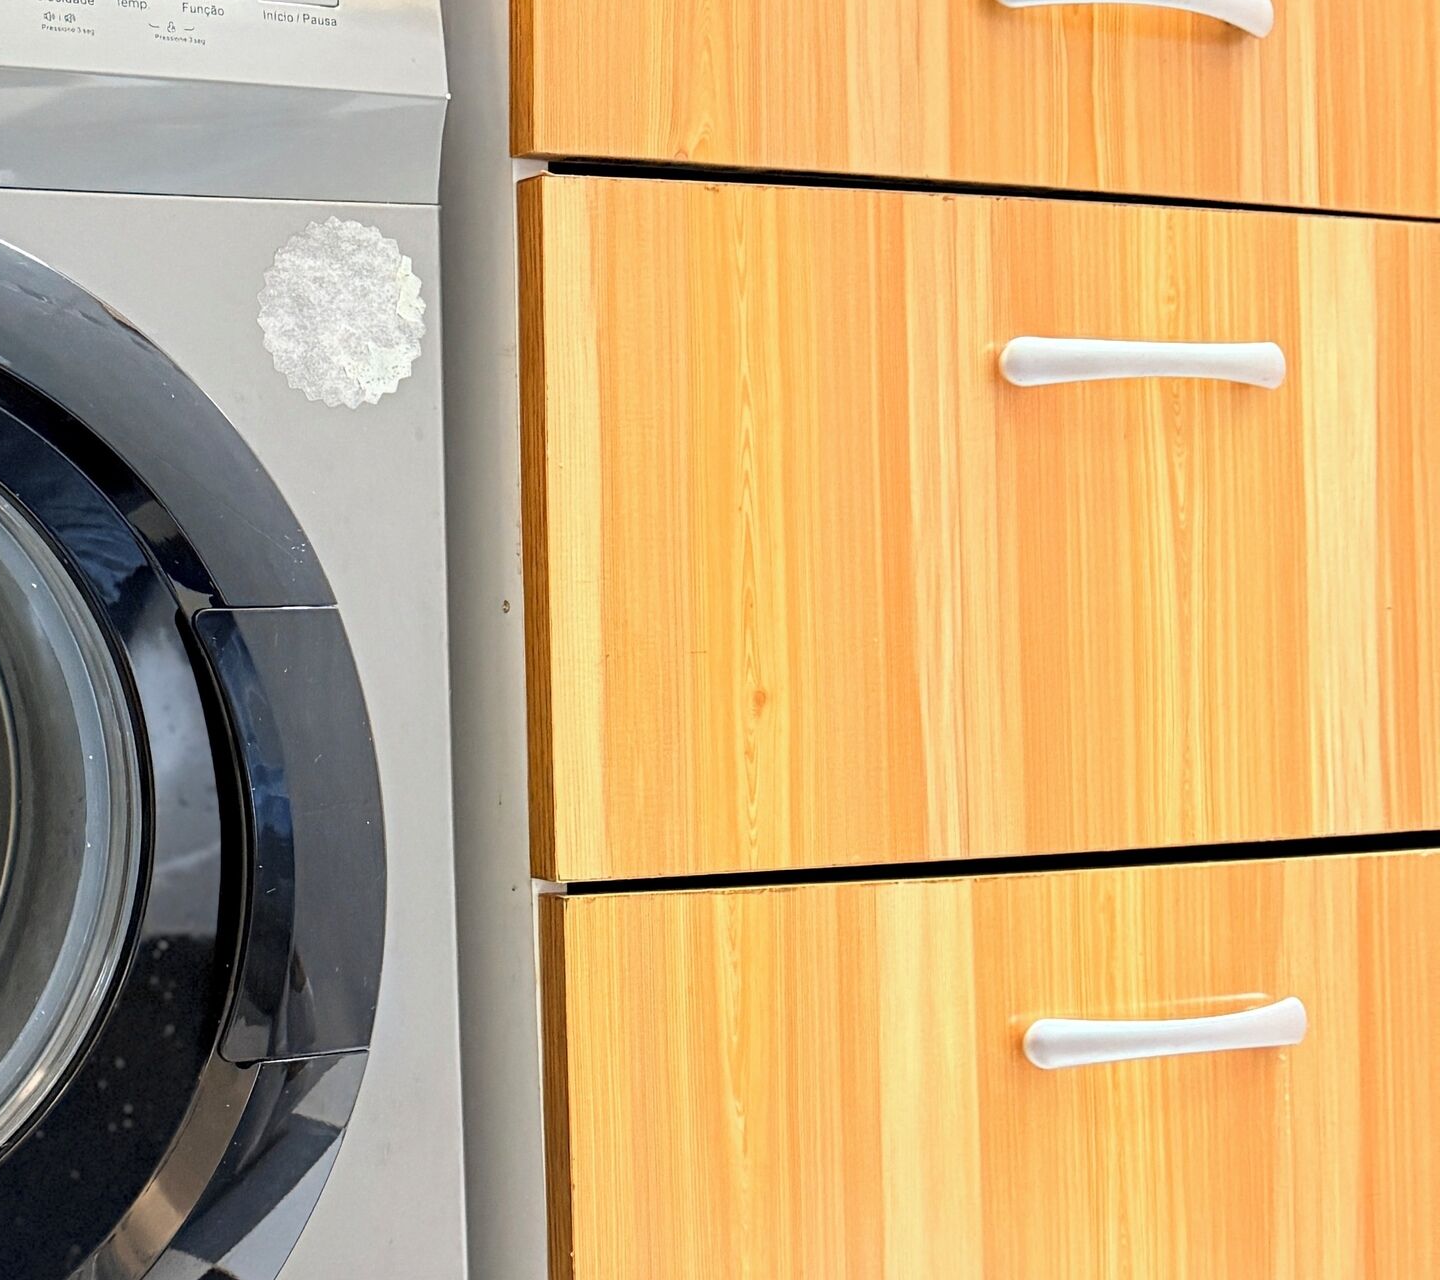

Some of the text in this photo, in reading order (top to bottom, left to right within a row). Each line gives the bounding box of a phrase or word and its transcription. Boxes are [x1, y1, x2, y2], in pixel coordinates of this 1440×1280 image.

[182, 2, 225, 16] Função
[263, 10, 294, 23] Início
[303, 13, 337, 27] Pausa
